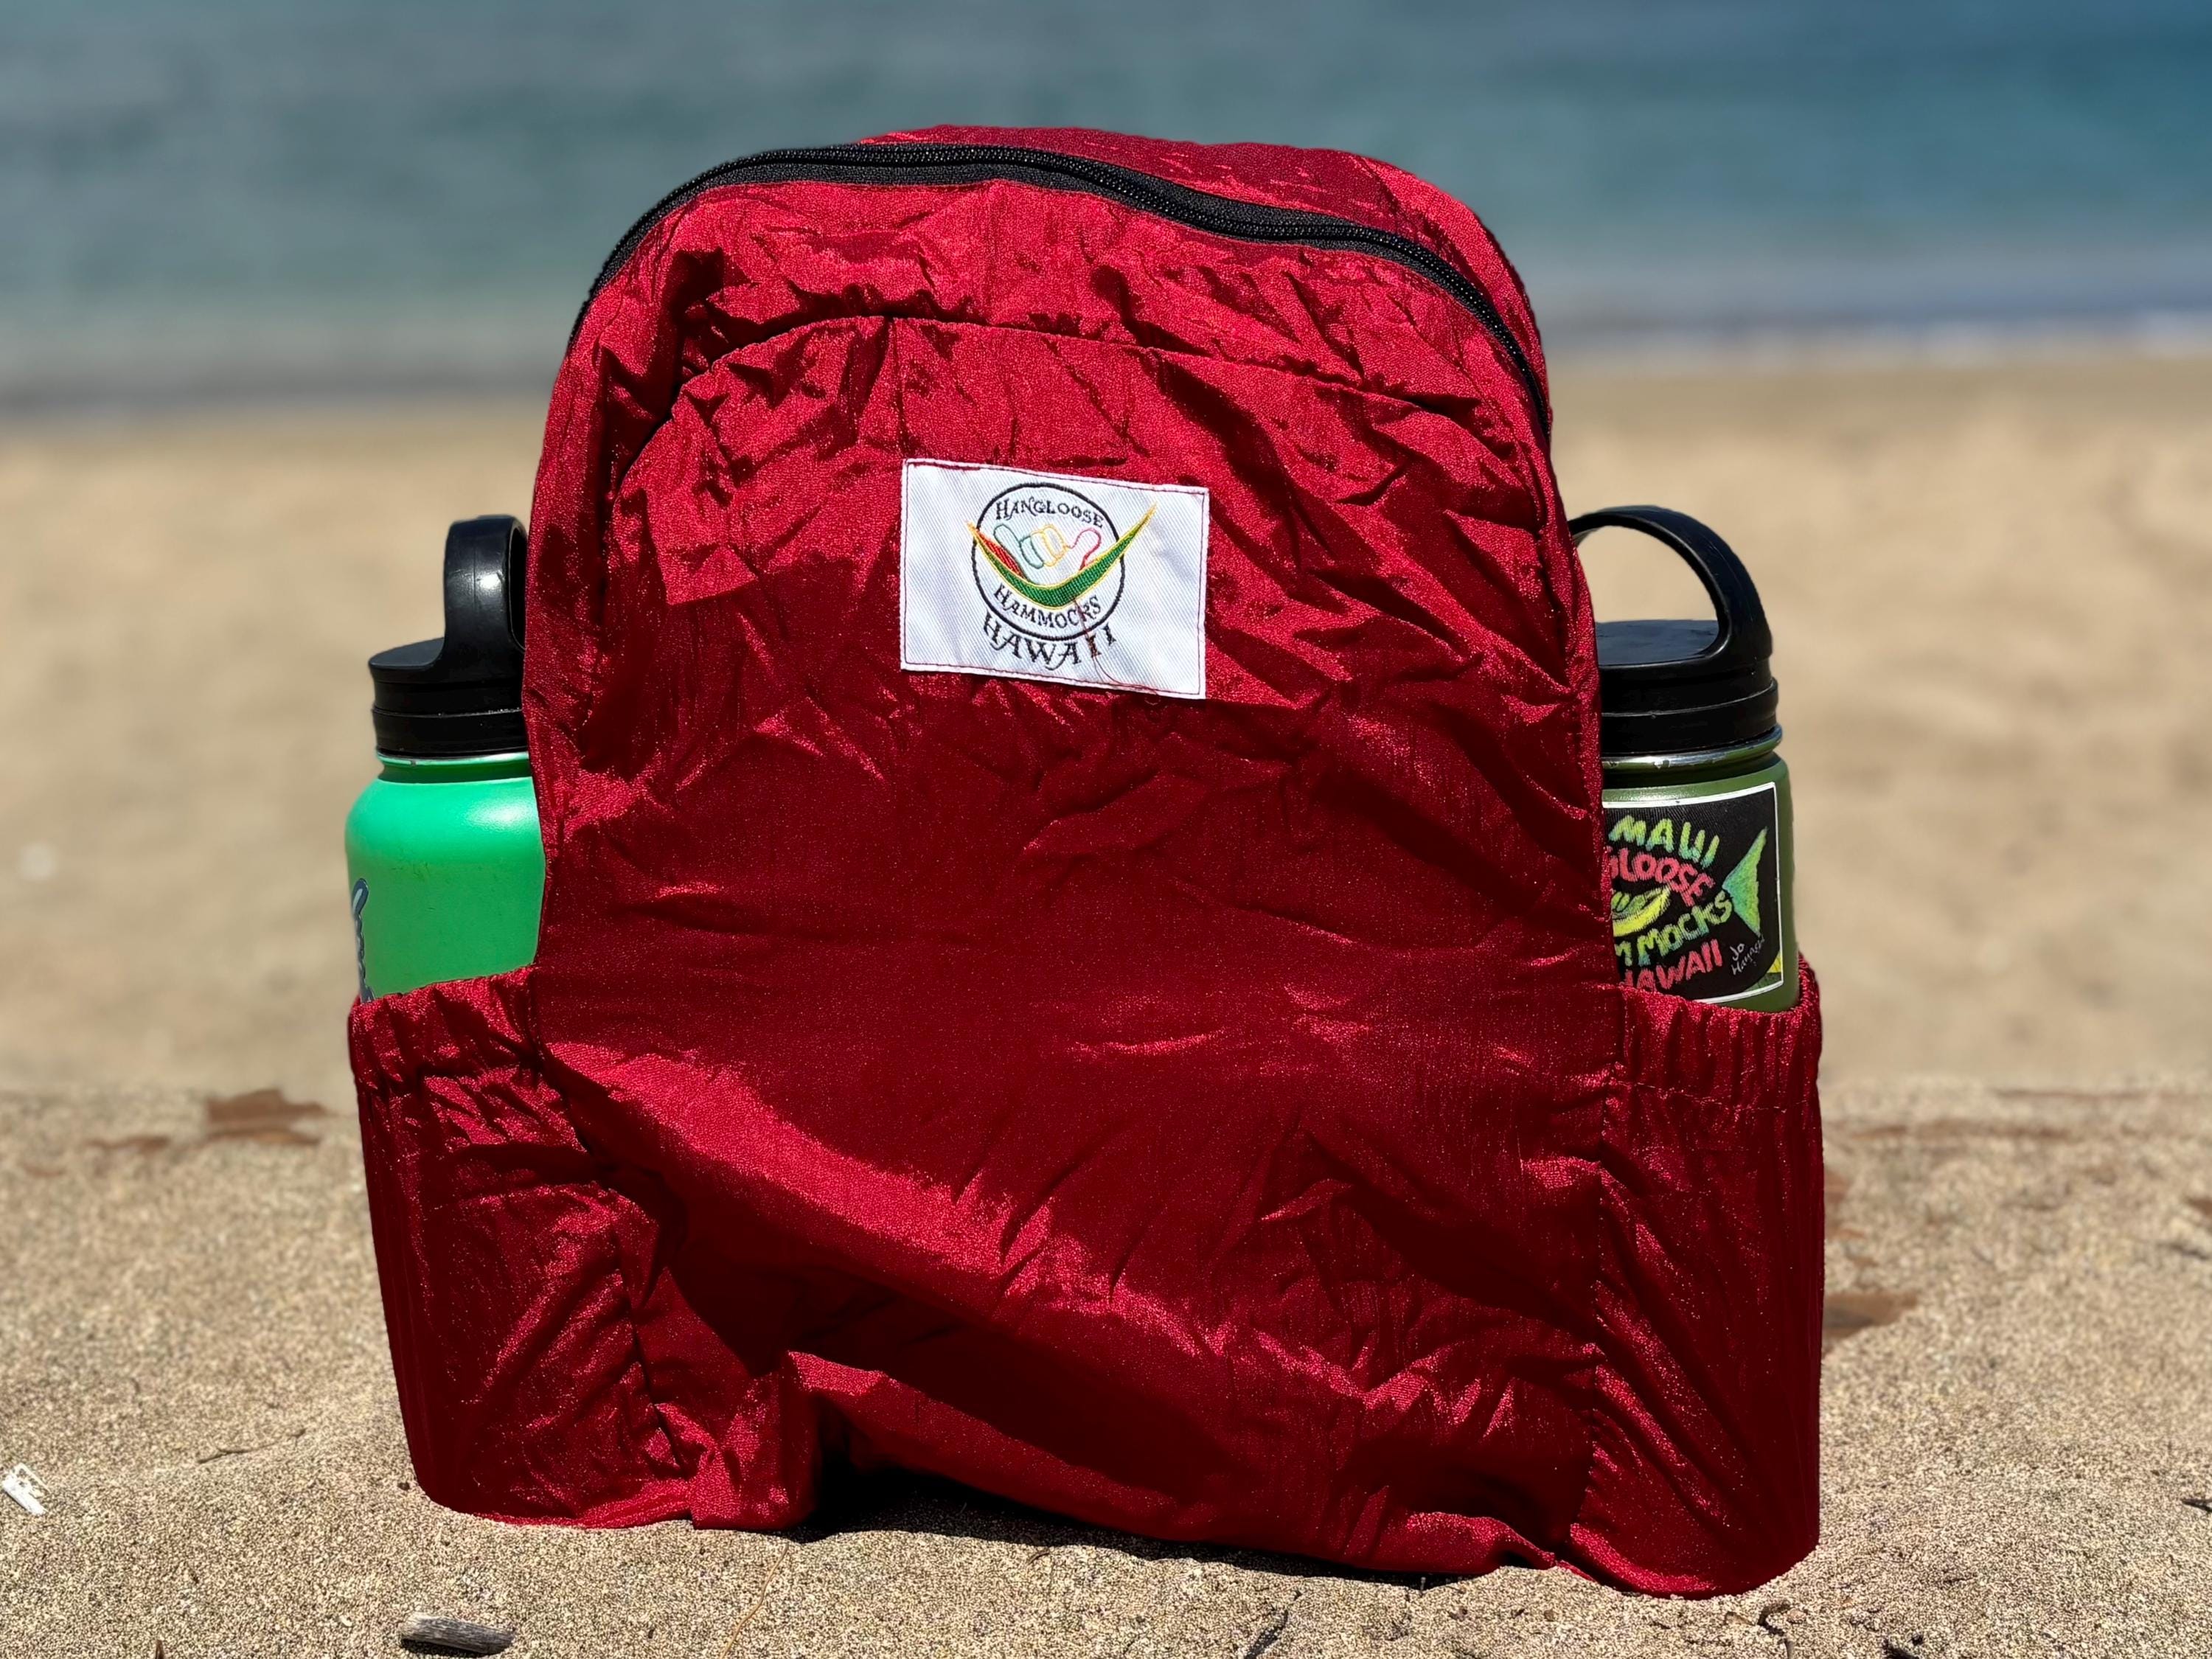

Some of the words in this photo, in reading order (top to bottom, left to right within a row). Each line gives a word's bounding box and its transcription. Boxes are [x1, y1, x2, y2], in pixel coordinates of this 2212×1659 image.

[995, 497, 1104, 529] HANGLOOSE
[994, 584, 1101, 629] HAMMOCKS
[984, 612, 1116, 670] HAWAII
[1608, 815, 1719, 868] MAUI
